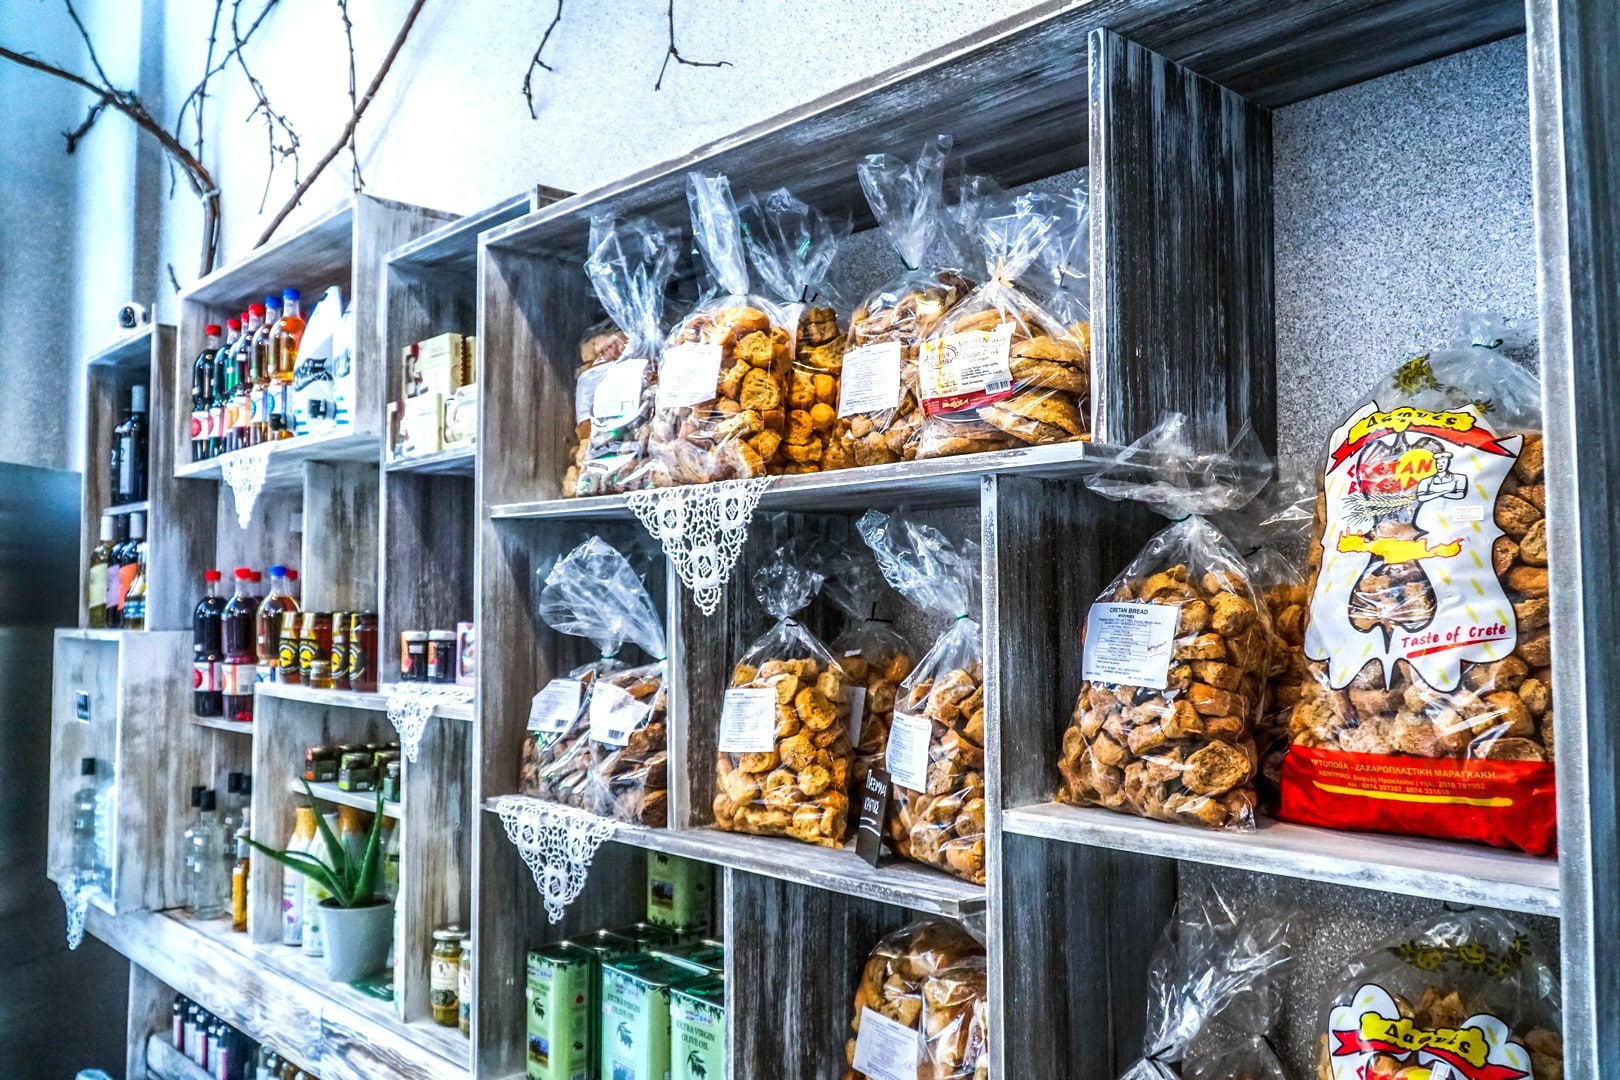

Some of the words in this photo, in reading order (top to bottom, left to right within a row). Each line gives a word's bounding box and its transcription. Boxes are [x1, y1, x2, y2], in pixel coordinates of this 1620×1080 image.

[1346, 458, 1434, 479] CRETAN
[1347, 476, 1419, 495] BREAD
[1128, 607, 1149, 615] BREAD
[1401, 632, 1440, 648] Taste
[1446, 626, 1462, 643] of
[1469, 623, 1507, 638] Crete
[676, 1020, 694, 1034] EXTRA
[694, 1026, 715, 1042] VIRGIN
